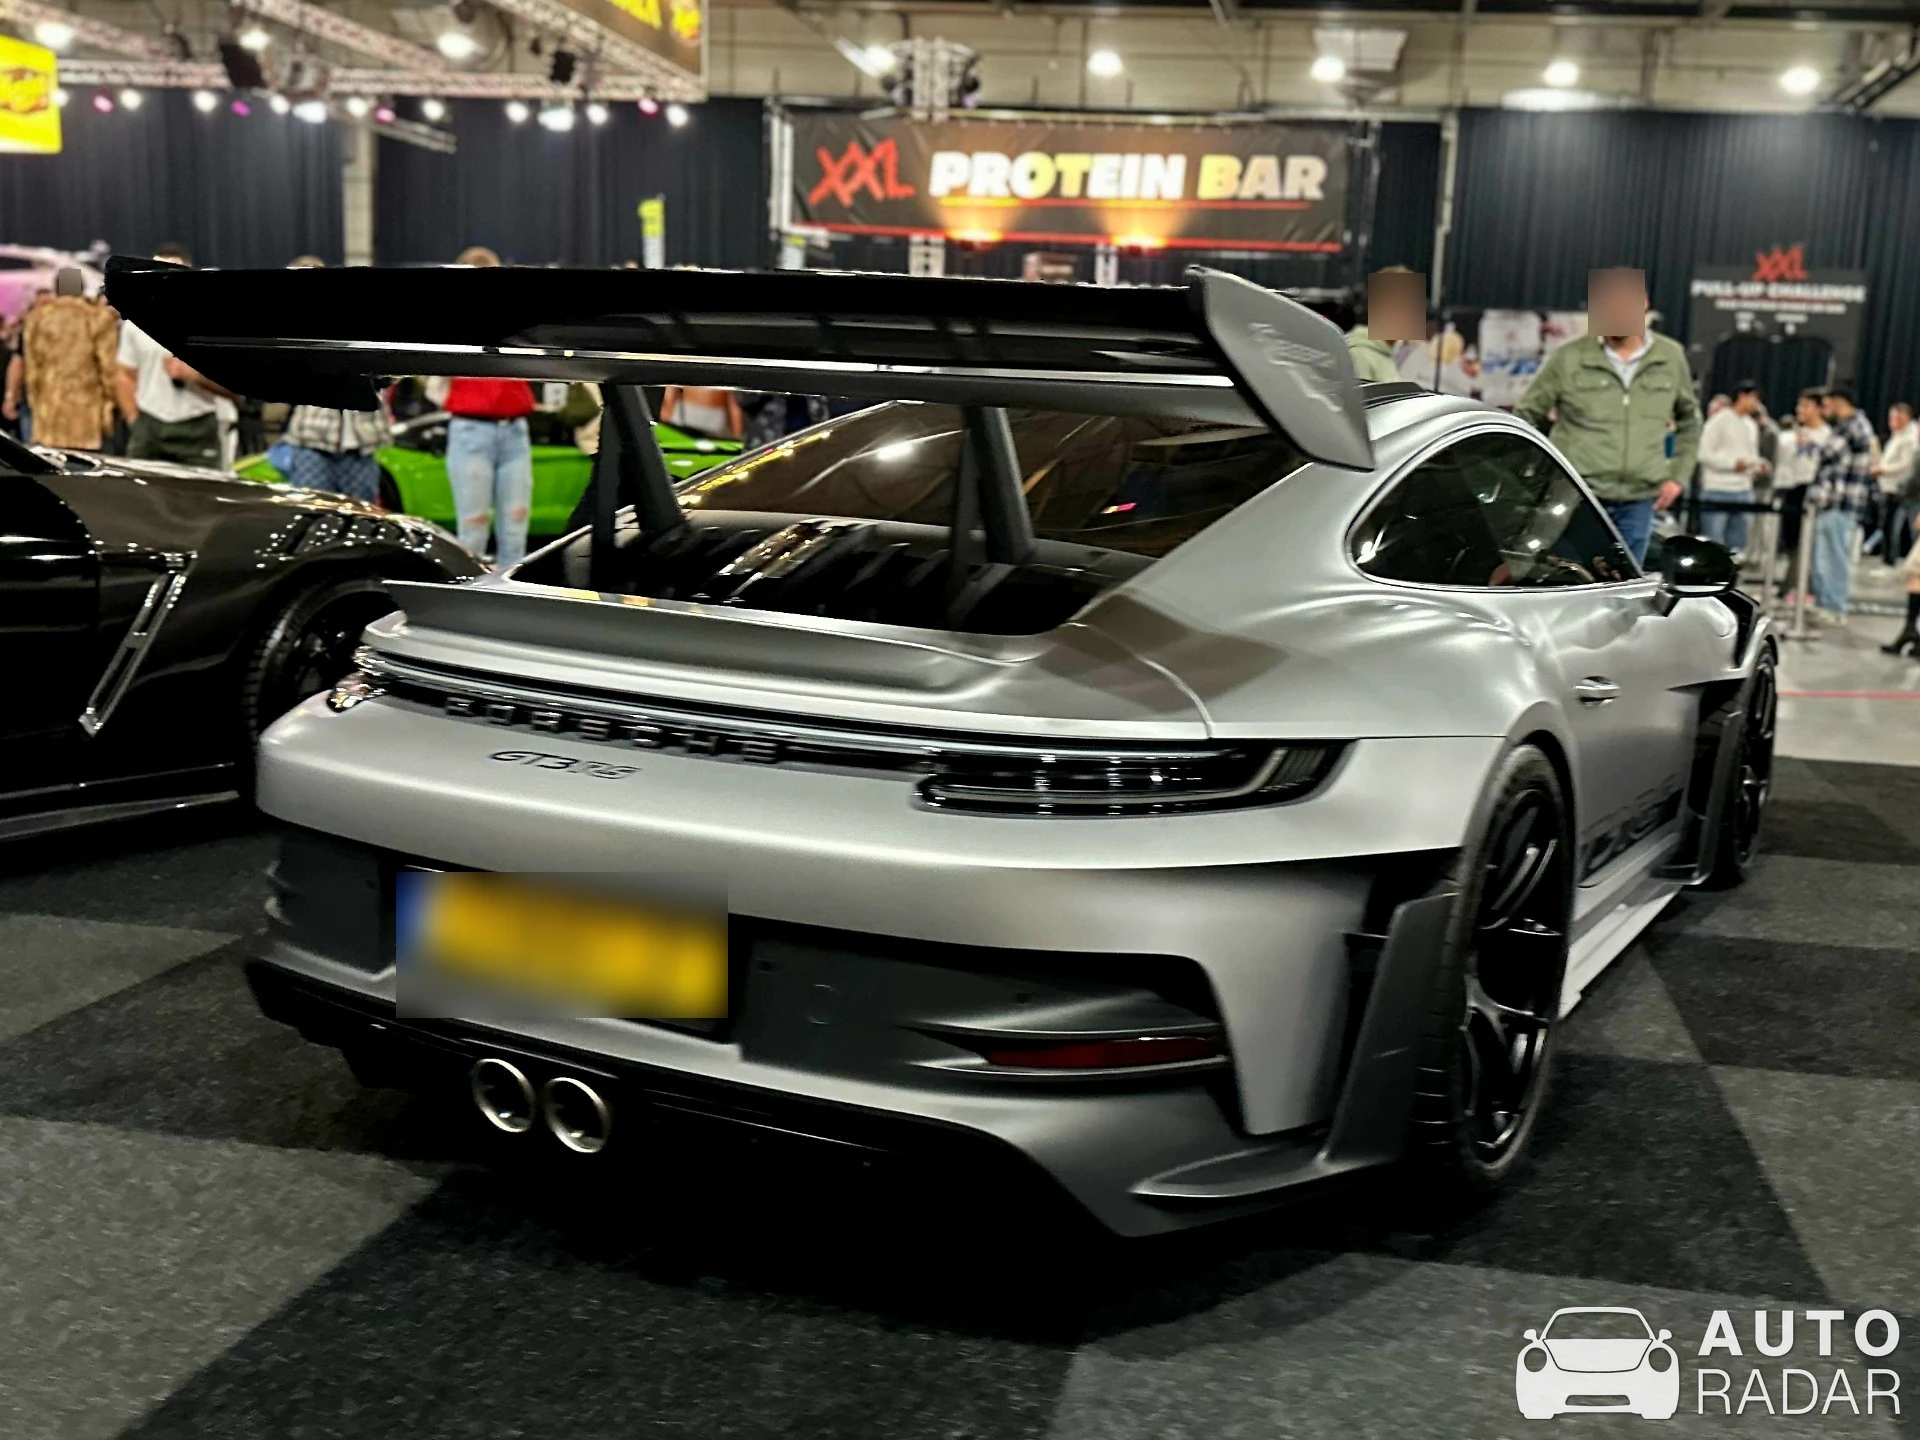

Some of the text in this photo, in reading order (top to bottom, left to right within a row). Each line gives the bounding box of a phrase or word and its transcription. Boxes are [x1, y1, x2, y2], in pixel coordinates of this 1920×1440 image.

[809, 138, 1328, 207] XXL PROTEIN BAR
[1753, 246, 1808, 281] XXL
[444, 697, 779, 764] PORSCHE
